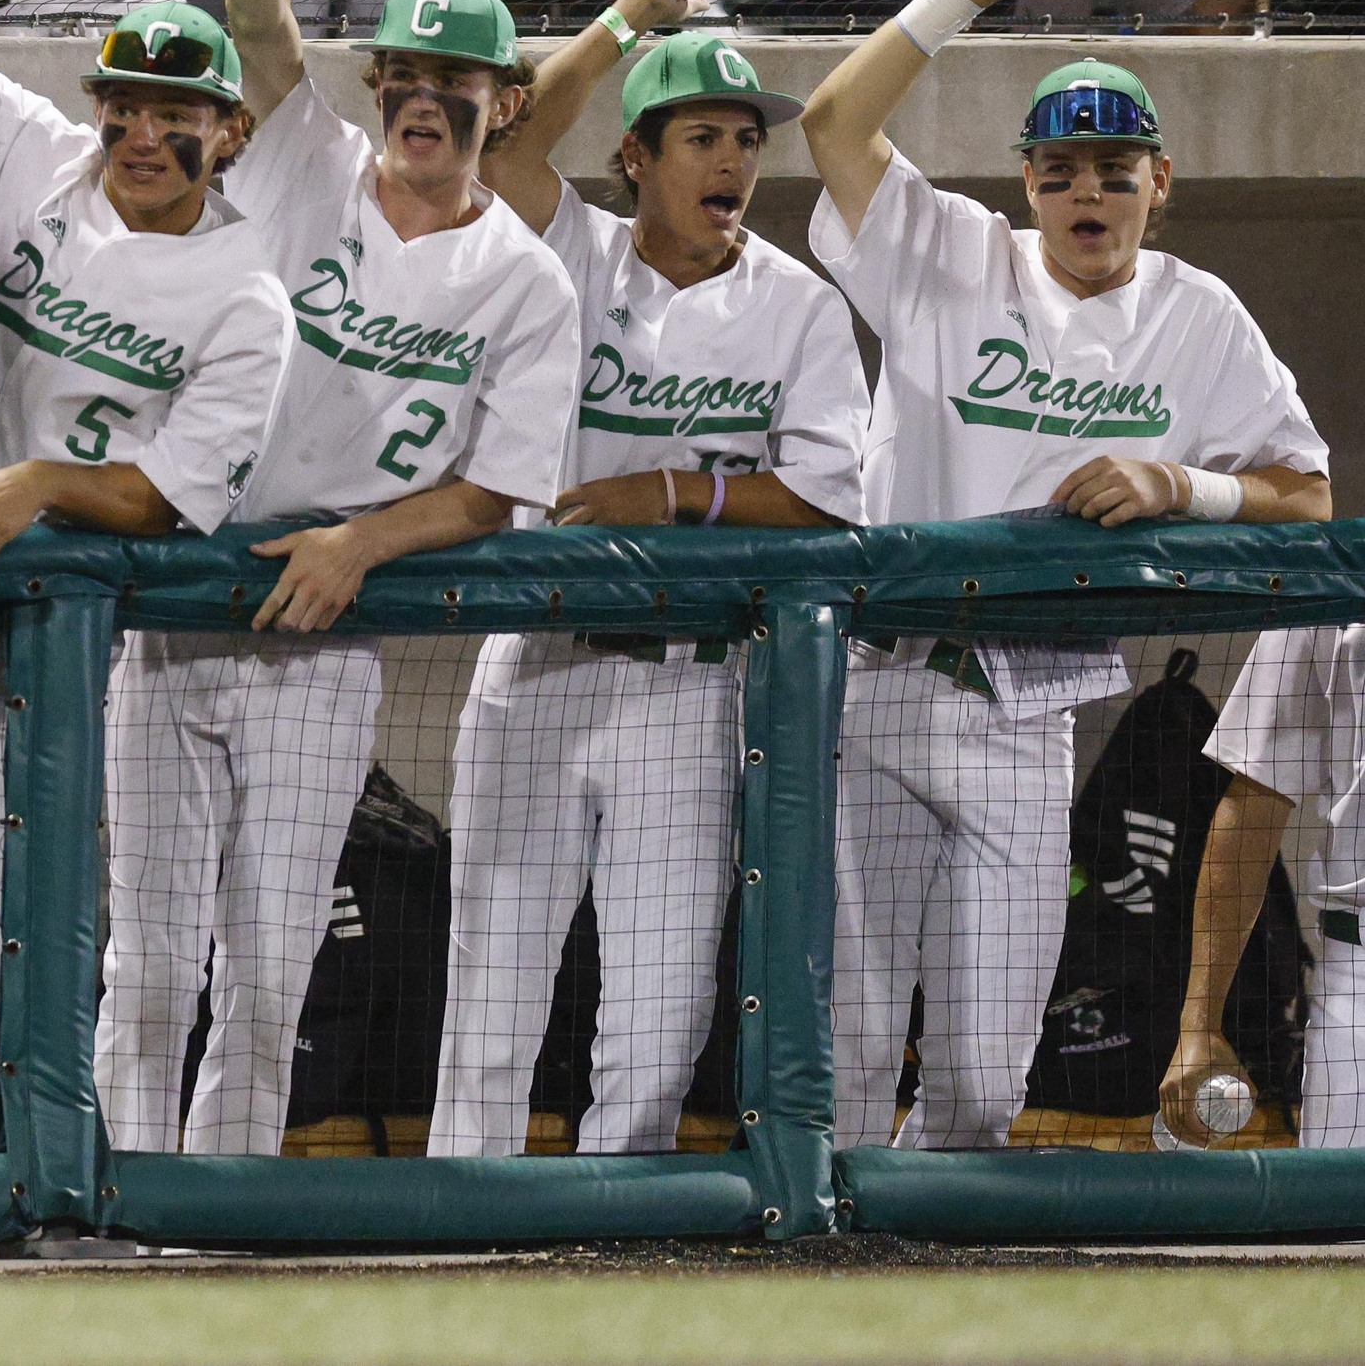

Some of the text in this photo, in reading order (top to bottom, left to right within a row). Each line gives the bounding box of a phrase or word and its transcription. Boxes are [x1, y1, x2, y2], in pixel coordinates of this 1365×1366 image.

[715, 48, 748, 89] C
[290, 258, 487, 384] Dragons
[65, 395, 137, 462] 5
[579, 342, 782, 437] Dragons
[375, 398, 447, 482] 2
